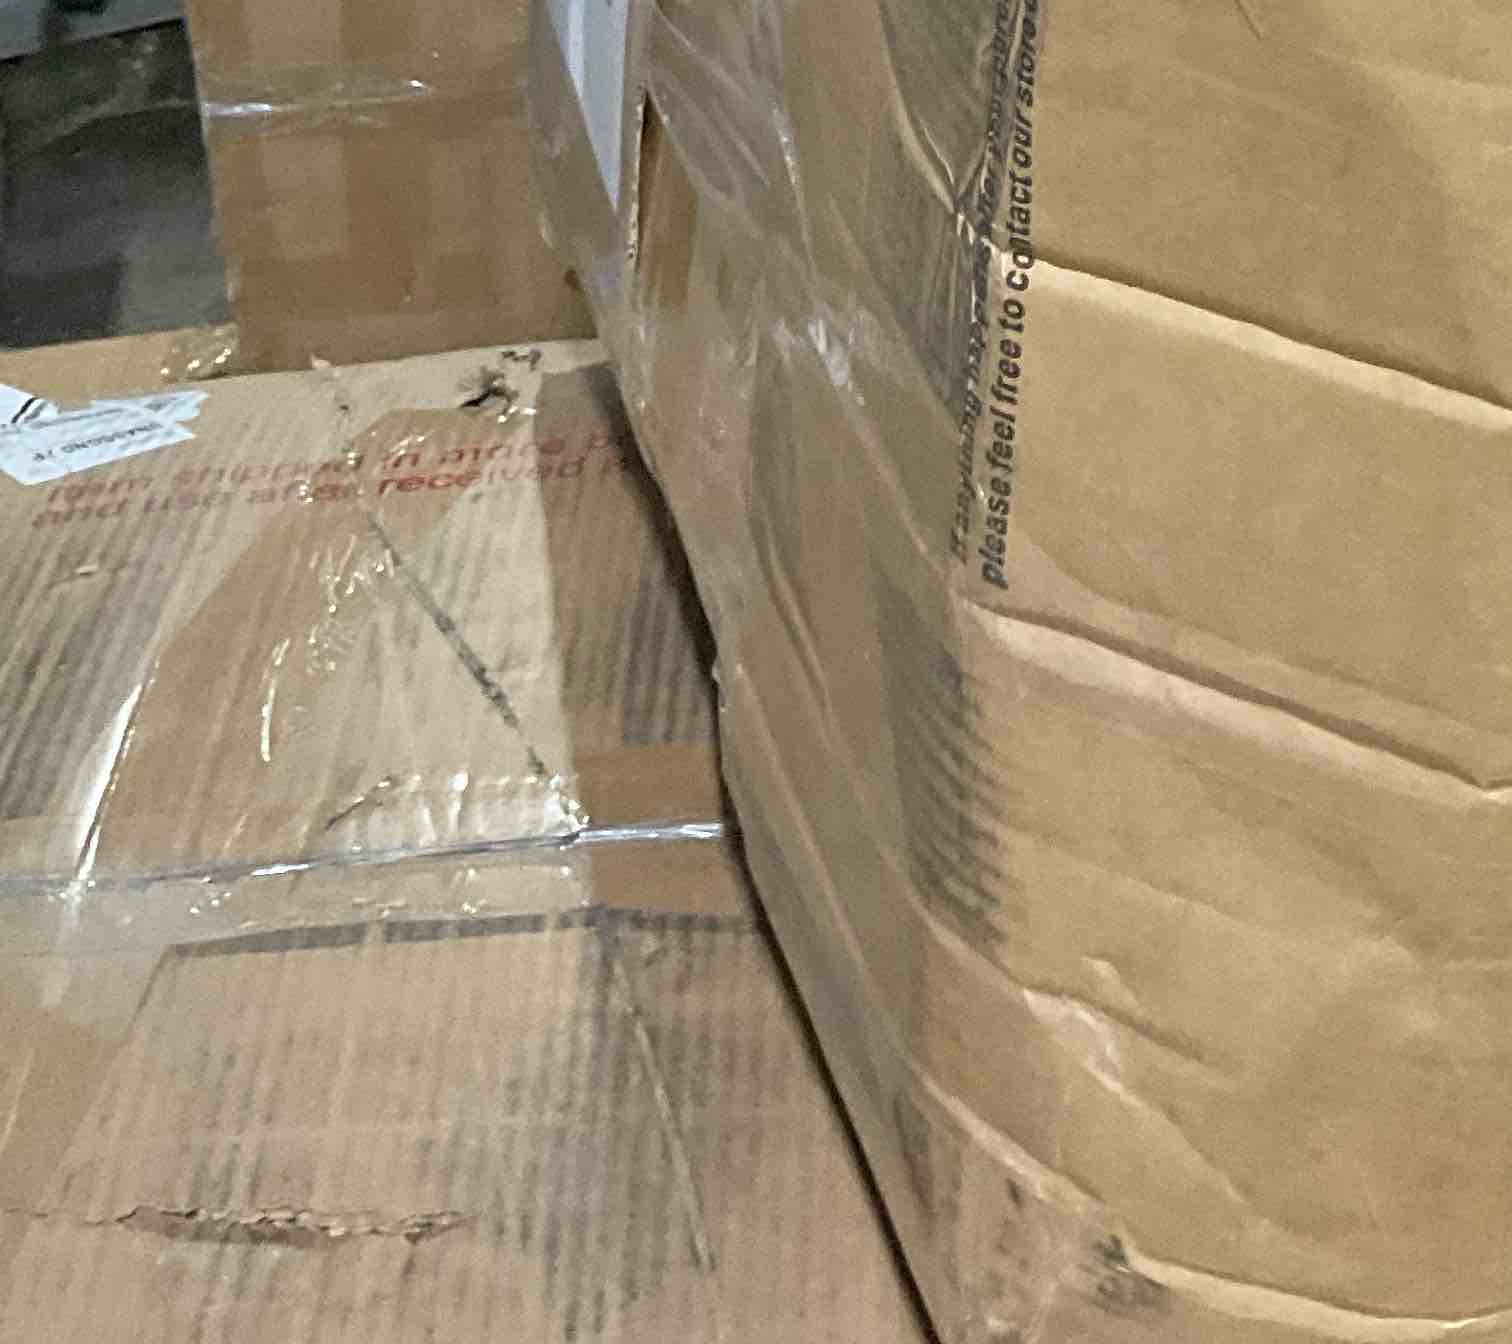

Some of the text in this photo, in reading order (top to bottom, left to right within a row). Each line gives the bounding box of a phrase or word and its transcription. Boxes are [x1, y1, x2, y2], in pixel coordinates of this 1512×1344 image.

[1016, 7, 1040, 107] store
[1011, 108, 1034, 169] our
[998, 297, 1026, 332] to
[989, 337, 1024, 404] free
[985, 404, 1017, 471] feel
[978, 476, 1009, 589] please
